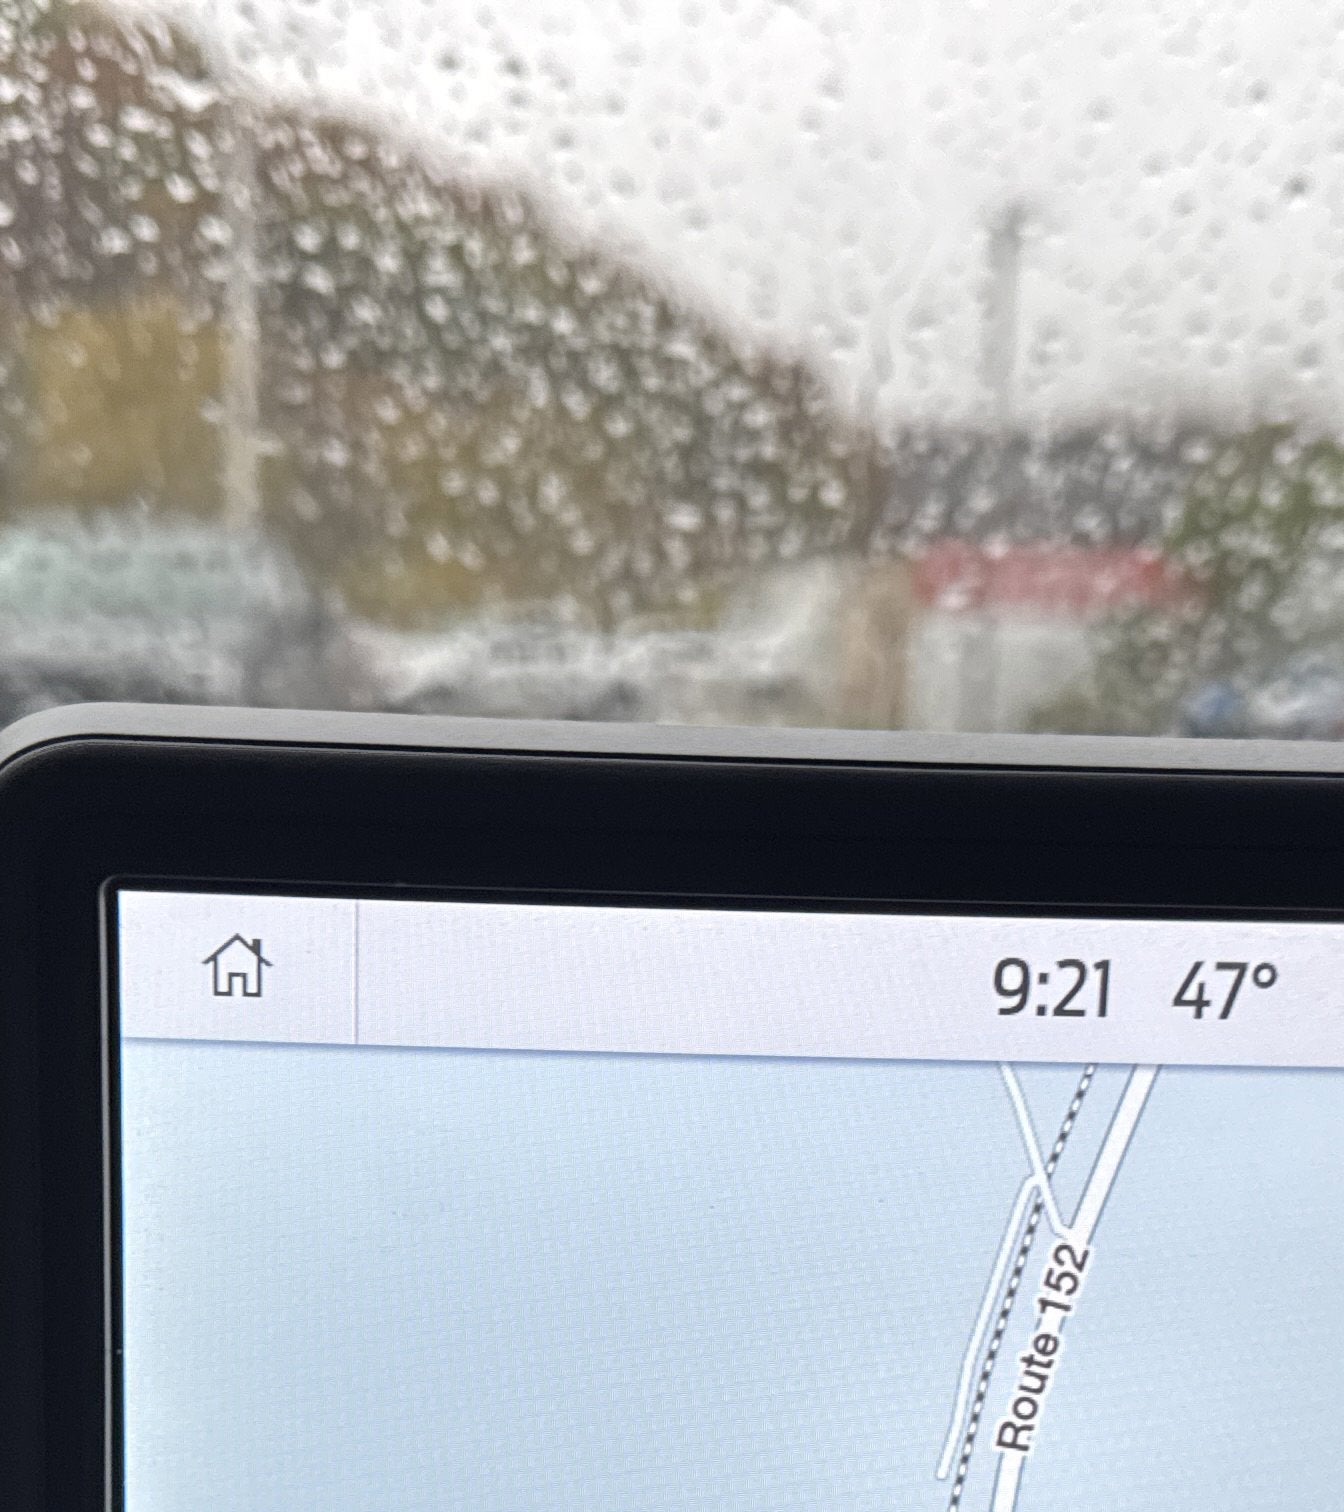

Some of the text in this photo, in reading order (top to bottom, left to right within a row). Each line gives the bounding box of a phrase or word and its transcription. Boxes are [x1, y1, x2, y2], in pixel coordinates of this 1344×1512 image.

[993, 957, 1110, 1017] 9:21
[1171, 960, 1278, 1020] 47°
[996, 1243, 1090, 1453] Route 152
